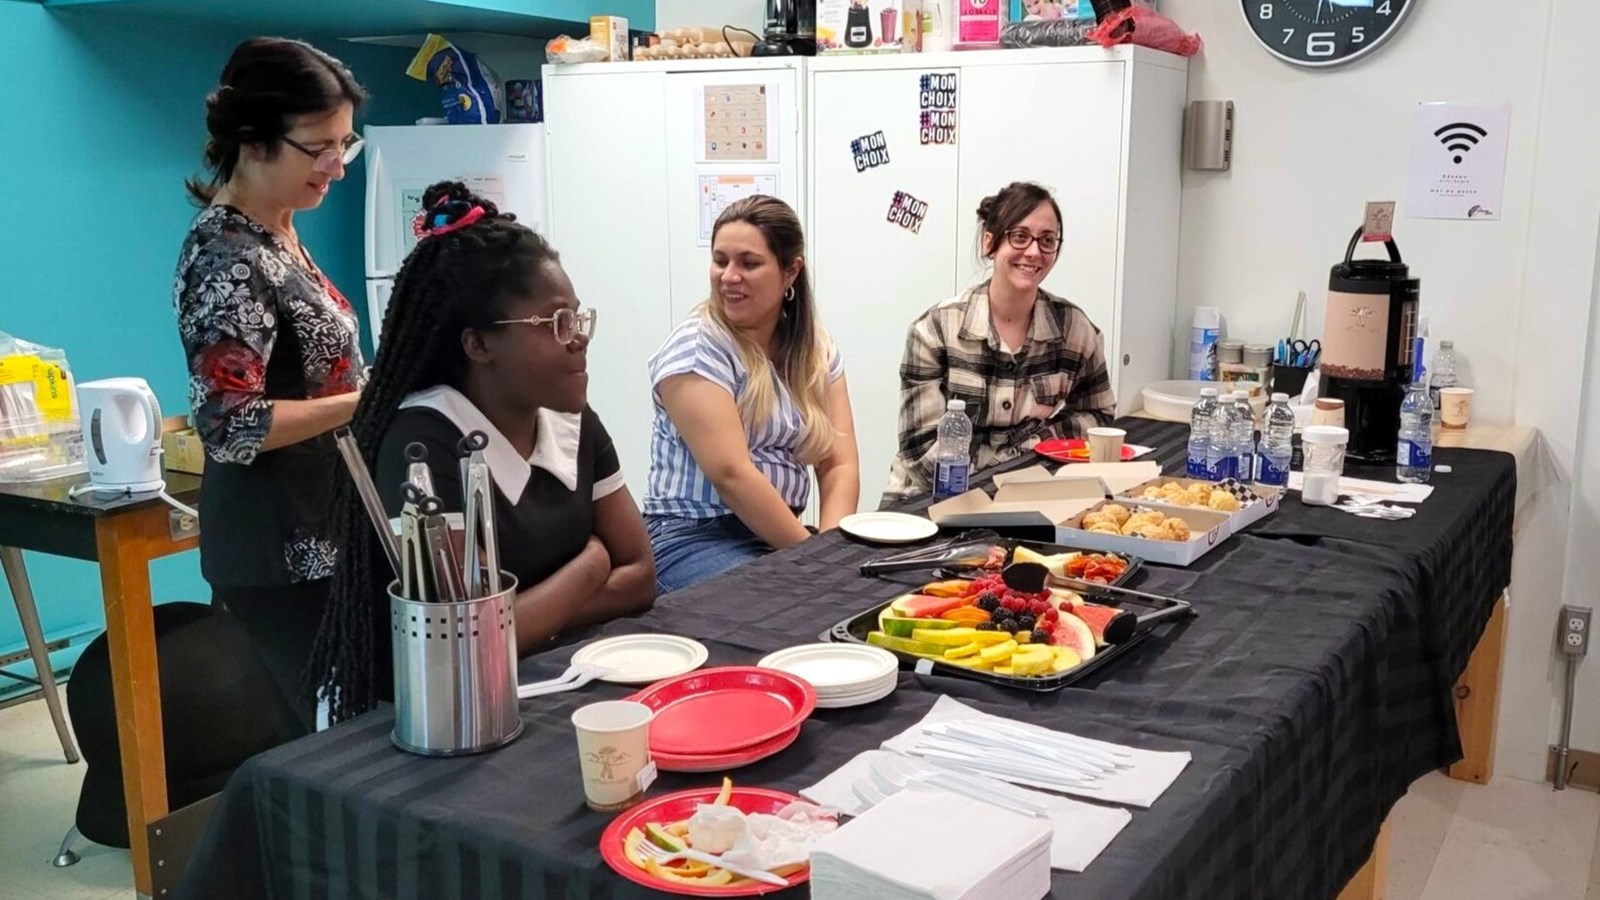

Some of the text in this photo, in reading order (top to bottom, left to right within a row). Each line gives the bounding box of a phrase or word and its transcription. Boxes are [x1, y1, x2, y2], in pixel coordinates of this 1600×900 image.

[1259, 4, 1273, 19] 8
[1376, 1, 1392, 15] 4
[1282, 28, 1295, 44] 7
[1351, 27, 1365, 43] 5
[1306, 32, 1336, 56] 6
[920, 75, 955, 90] #MON
[921, 91, 955, 107] CHOIX
[920, 111, 955, 127] #MON
[850, 132, 885, 156] #MON
[921, 128, 955, 144] CHOIX
[855, 148, 889, 170] CHOIX
[893, 190, 927, 219] #MON
[888, 206, 920, 234] CHOIX
